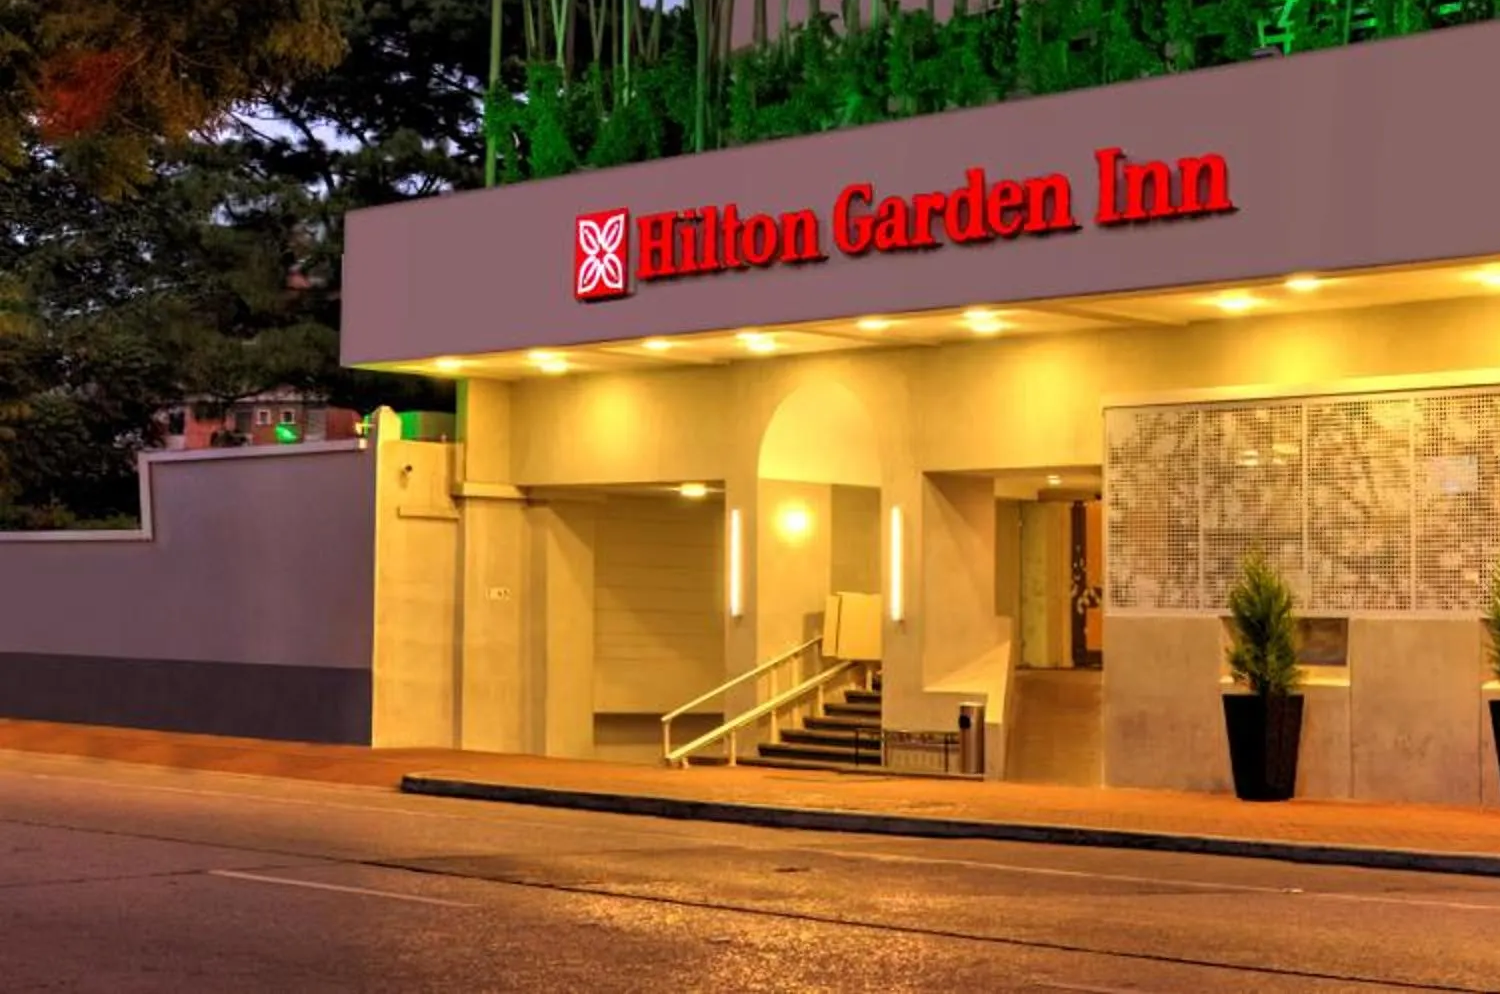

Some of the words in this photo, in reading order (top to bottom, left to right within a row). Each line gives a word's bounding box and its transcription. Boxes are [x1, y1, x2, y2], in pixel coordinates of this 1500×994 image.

[634, 204, 822, 280] Hilton
[831, 166, 1075, 253] Garden
[1093, 146, 1233, 224] Inn
